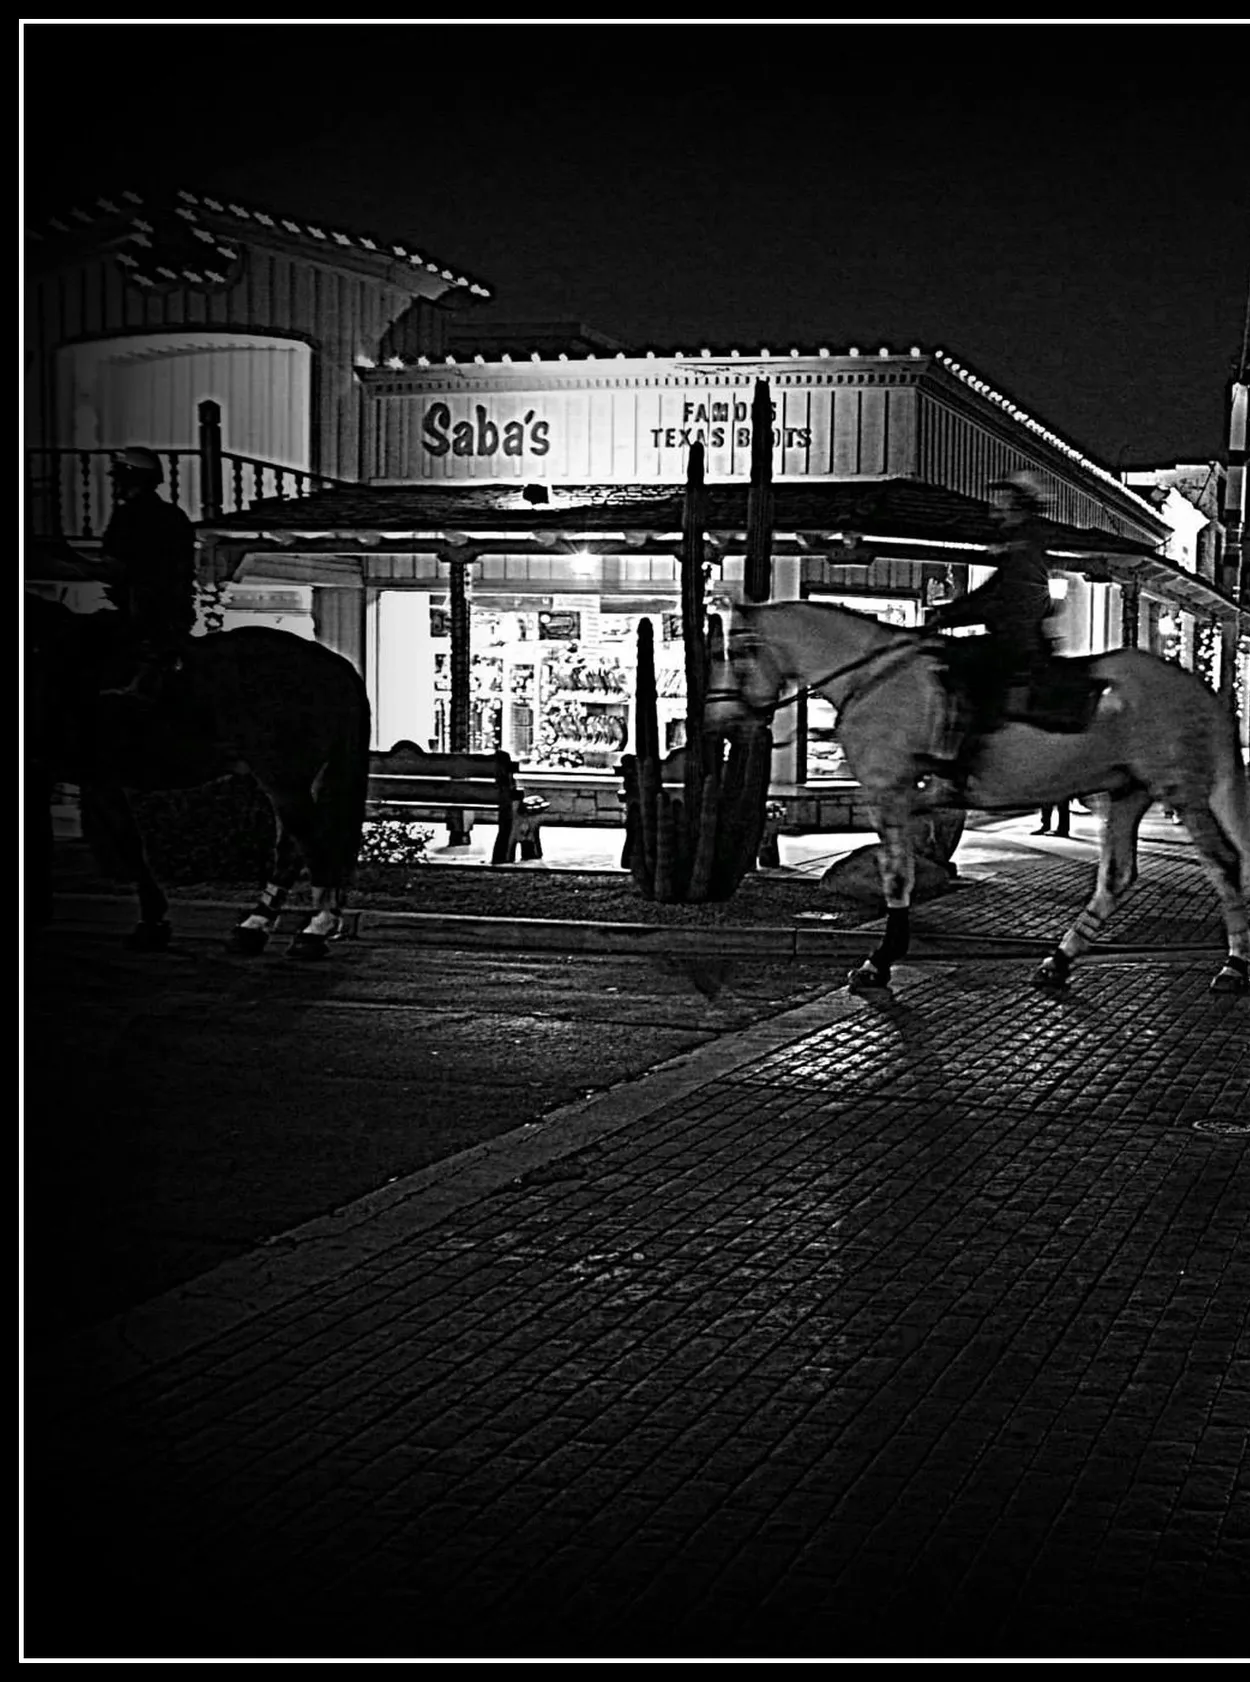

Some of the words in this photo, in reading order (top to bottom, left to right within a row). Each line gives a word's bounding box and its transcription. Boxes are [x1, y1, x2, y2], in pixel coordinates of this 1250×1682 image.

[684, 402, 777, 422] FAMOS
[422, 402, 550, 457] Saba's
[650, 428, 725, 448] TEXAS
[736, 427, 812, 448] BTS
